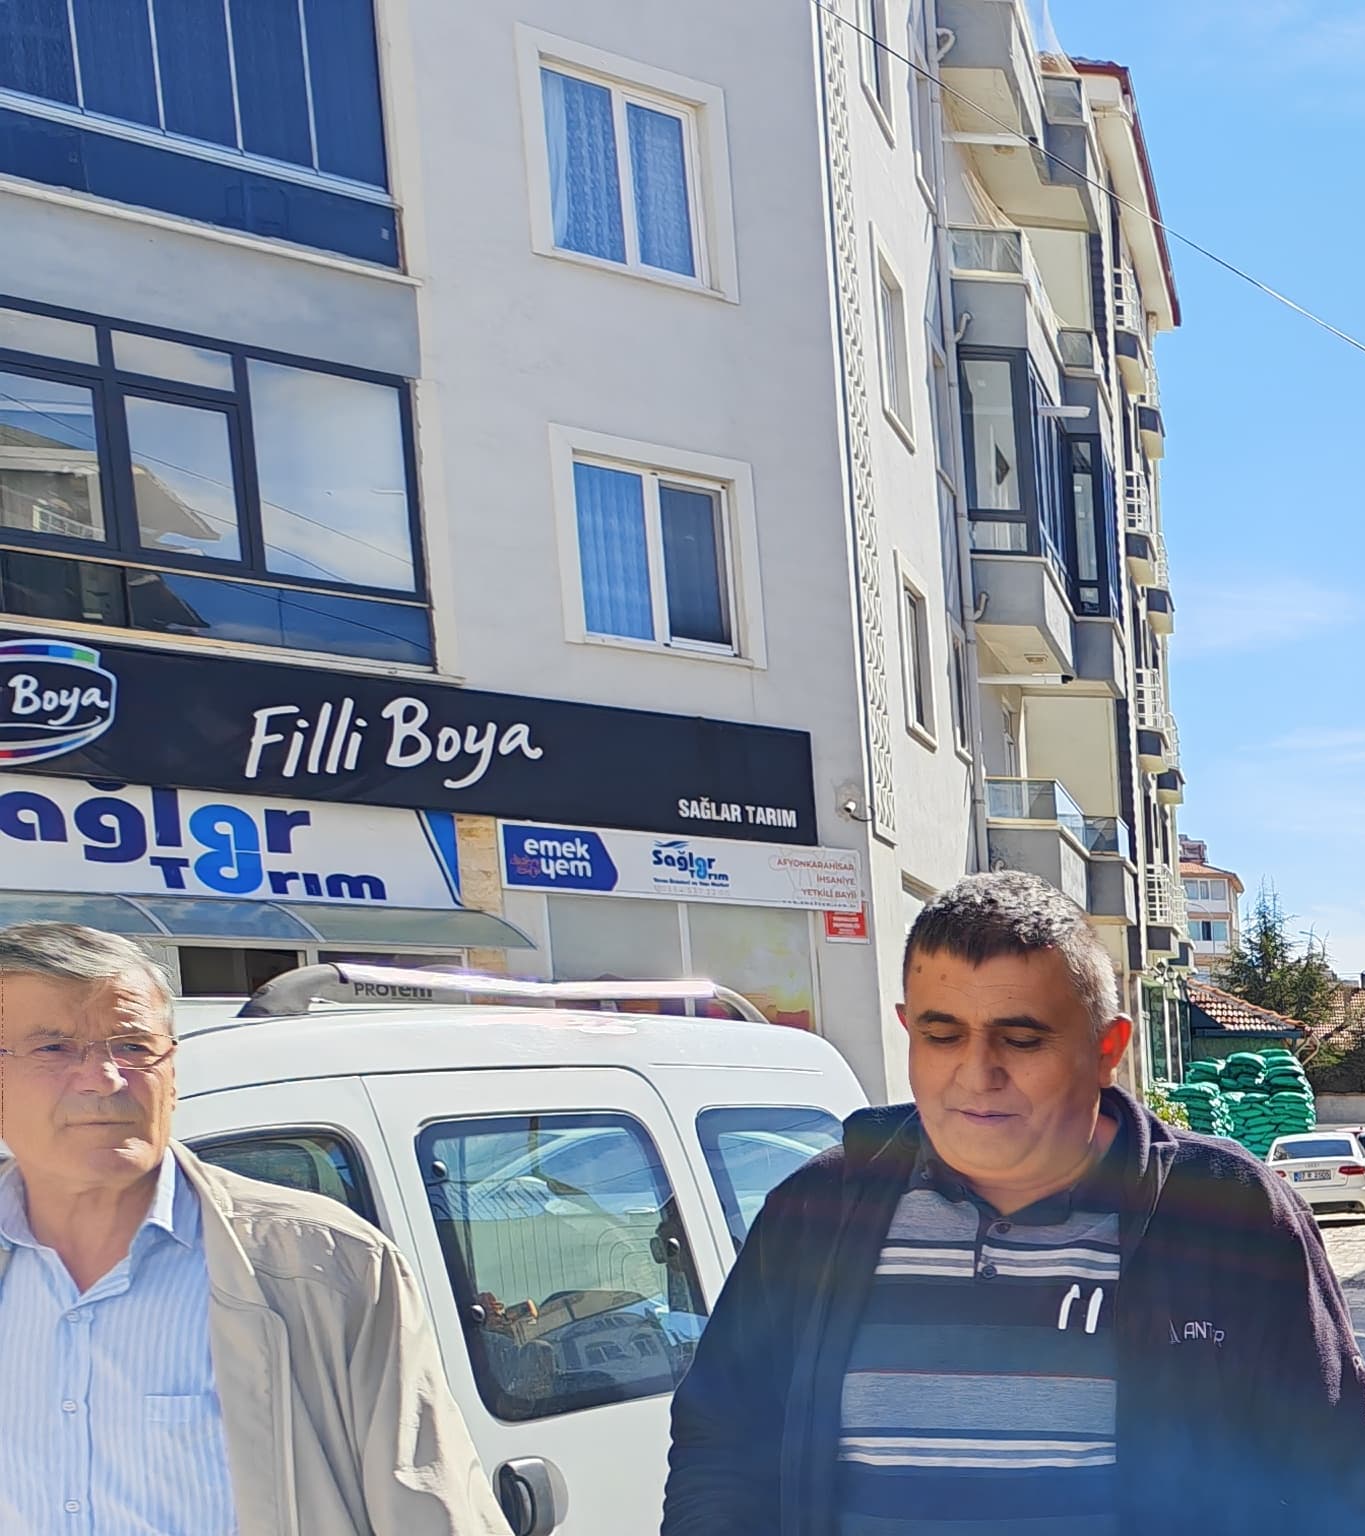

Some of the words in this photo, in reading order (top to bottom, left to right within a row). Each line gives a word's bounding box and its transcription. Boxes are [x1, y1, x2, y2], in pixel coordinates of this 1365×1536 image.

[8, 674, 110, 726] Boya
[245, 697, 369, 778] Filli
[381, 697, 543, 789] Boya
[678, 797, 742, 823] SAĞLAR
[745, 805, 797, 828] TARIM
[524, 838, 591, 860] emek
[541, 857, 592, 880] yem
